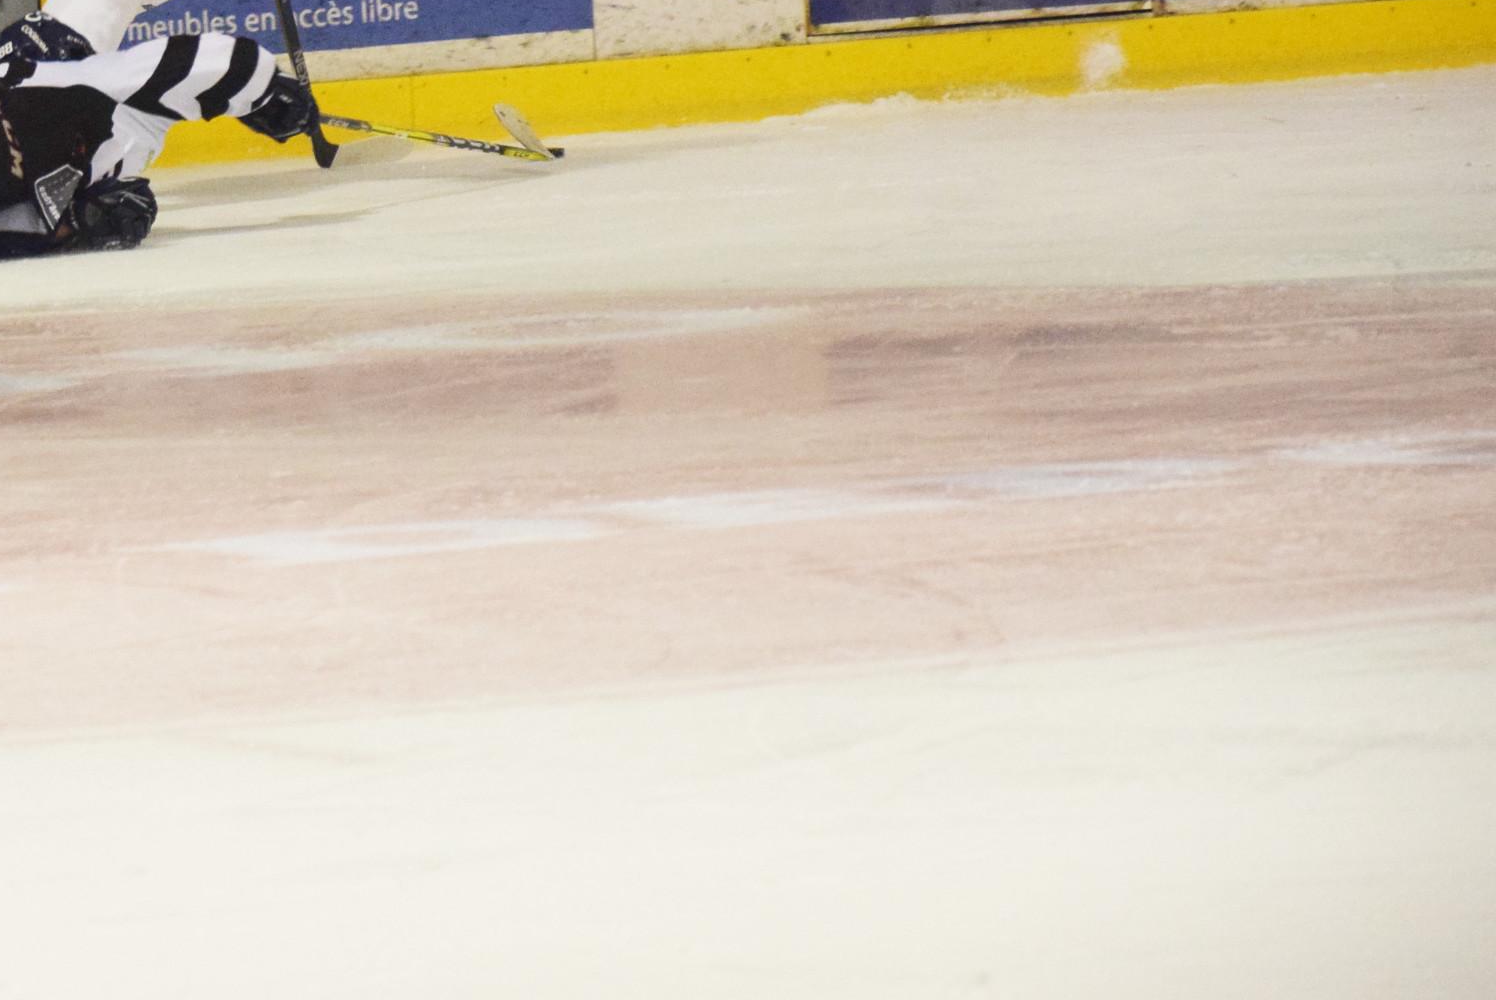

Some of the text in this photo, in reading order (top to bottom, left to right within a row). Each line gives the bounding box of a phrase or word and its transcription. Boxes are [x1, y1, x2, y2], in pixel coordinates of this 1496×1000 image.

[127, 8, 237, 41] meubles
[244, 11, 277, 33] en
[293, 0, 353, 29] ccès
